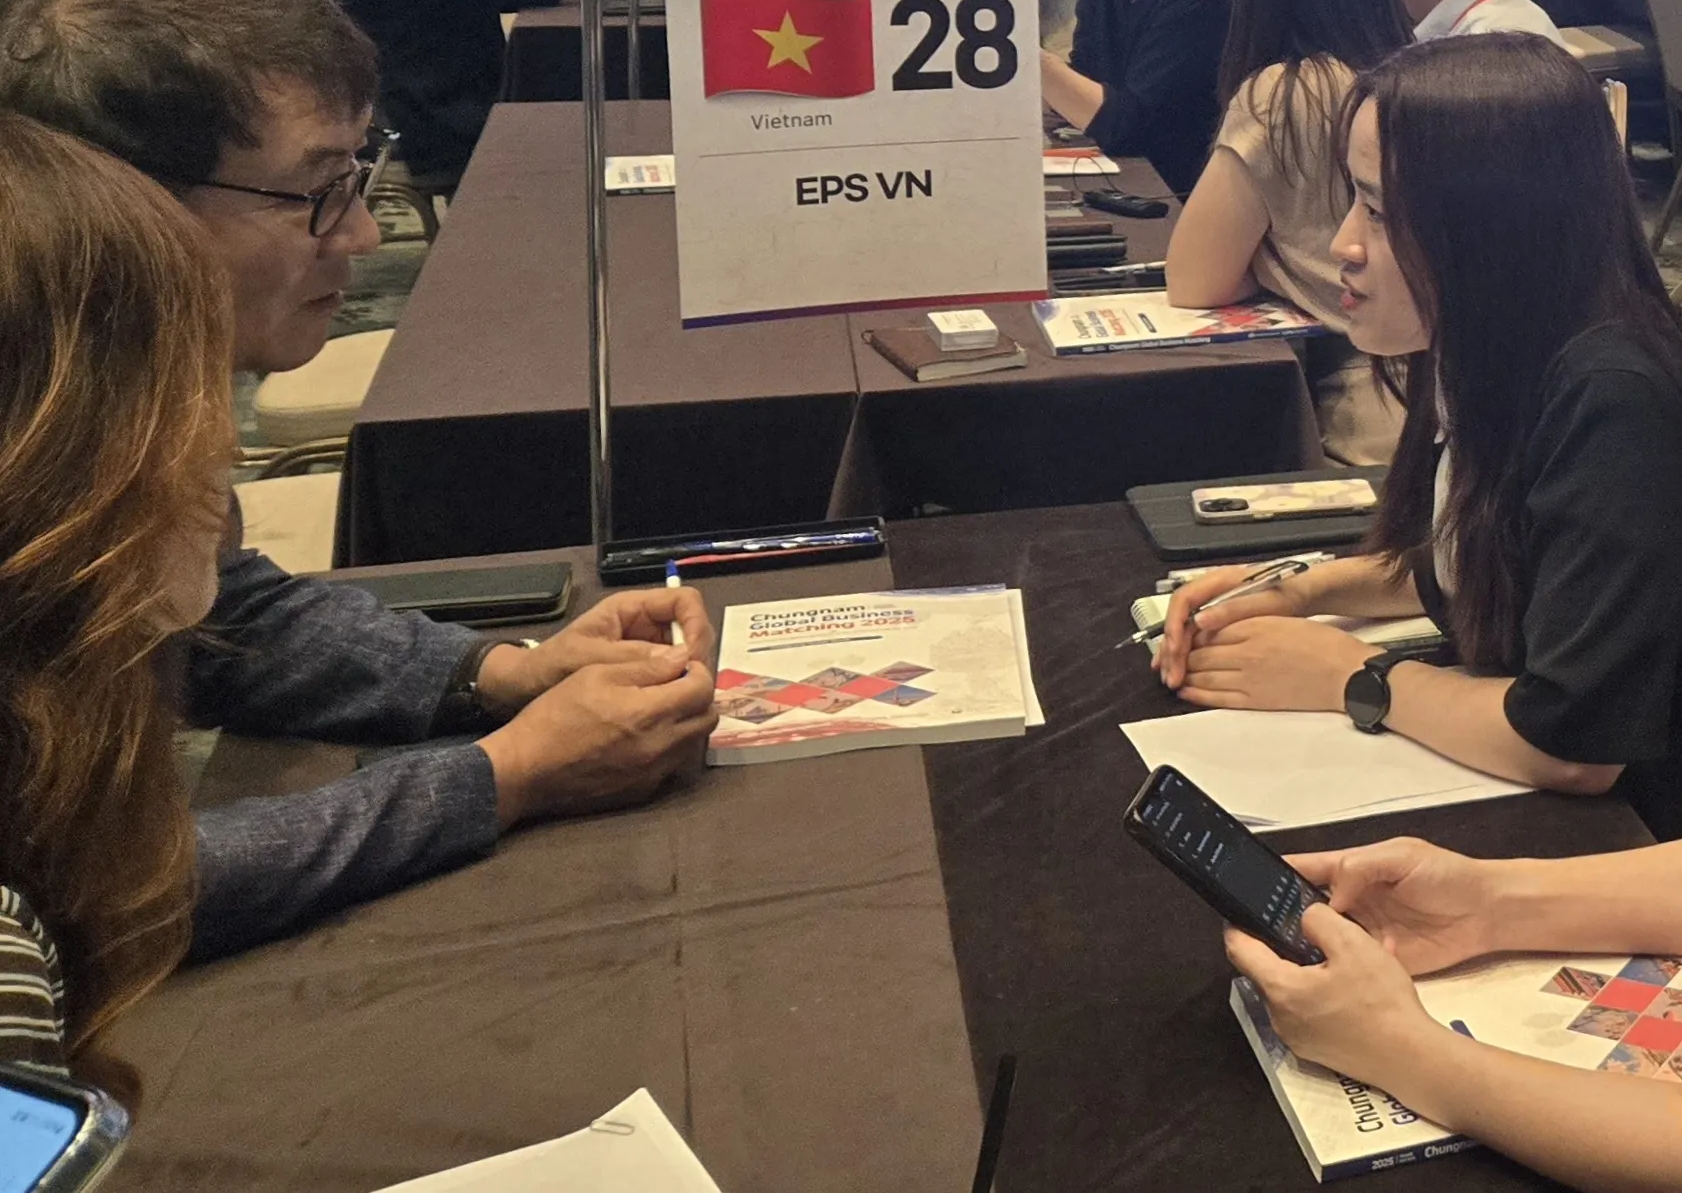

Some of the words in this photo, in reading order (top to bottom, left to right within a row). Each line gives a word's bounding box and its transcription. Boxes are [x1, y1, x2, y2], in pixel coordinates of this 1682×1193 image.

[750, 111, 833, 132] Vietnam
[796, 173, 869, 206] EPS
[875, 170, 932, 200] VN
[750, 604, 865, 622] Chungnam
[750, 616, 816, 630] Global
[822, 609, 914, 622] Business
[749, 621, 855, 639] Matching
[861, 615, 916, 627] 2025
[1339, 1074, 1384, 1133] Chung
[1371, 1156, 1395, 1170] 2025
[1424, 1140, 1476, 1158] Chungn
